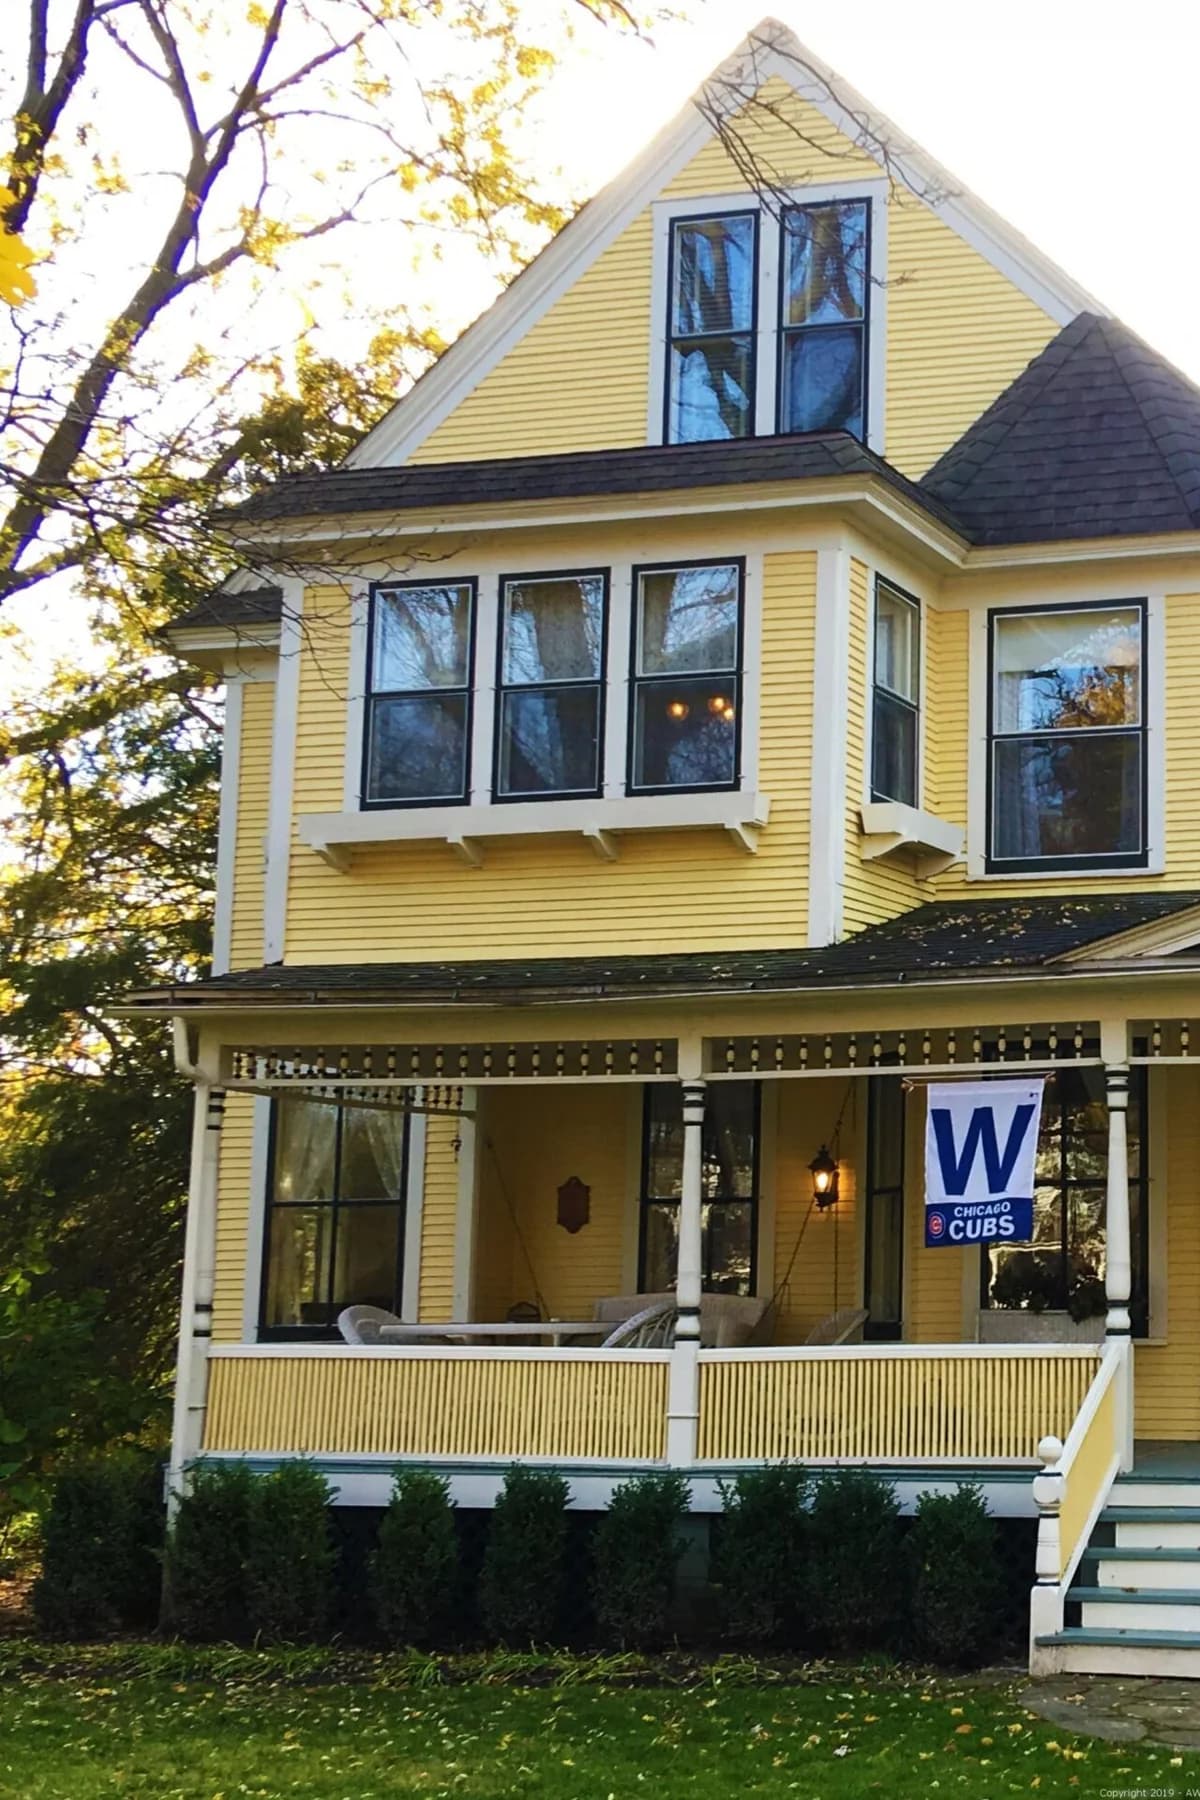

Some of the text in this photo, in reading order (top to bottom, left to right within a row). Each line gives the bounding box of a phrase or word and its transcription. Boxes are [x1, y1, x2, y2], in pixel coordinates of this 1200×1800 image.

[931, 1104, 1036, 1195] W
[954, 1201, 1011, 1217] CHICAGO
[949, 1215, 1015, 1240] CUBS
